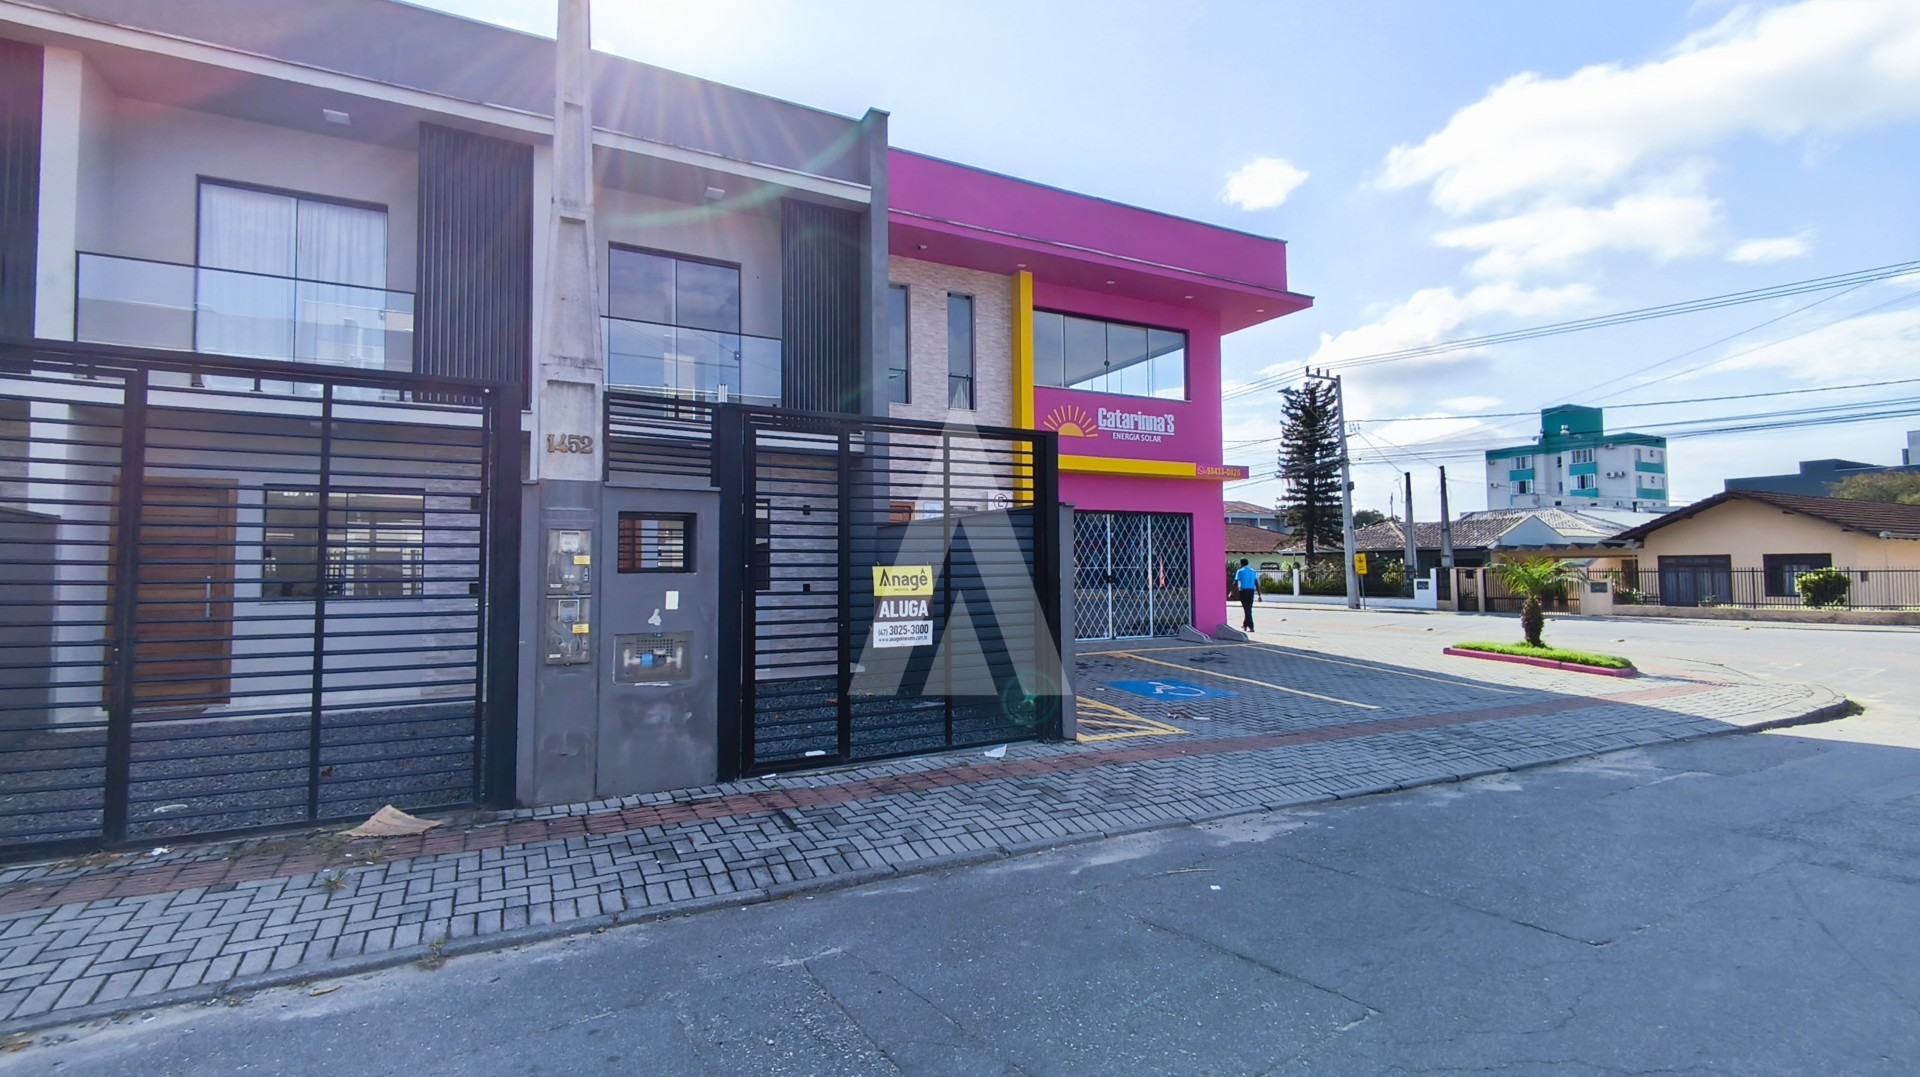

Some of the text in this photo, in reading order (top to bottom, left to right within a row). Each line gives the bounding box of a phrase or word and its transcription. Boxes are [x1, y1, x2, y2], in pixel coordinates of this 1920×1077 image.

[546, 433, 593, 454] 1452
[1112, 432, 1162, 443] ENERGIA SOLAR
[879, 568, 928, 591] Anagê
[879, 600, 929, 618] ALUGA
[889, 624, 929, 635] 3025-3000
